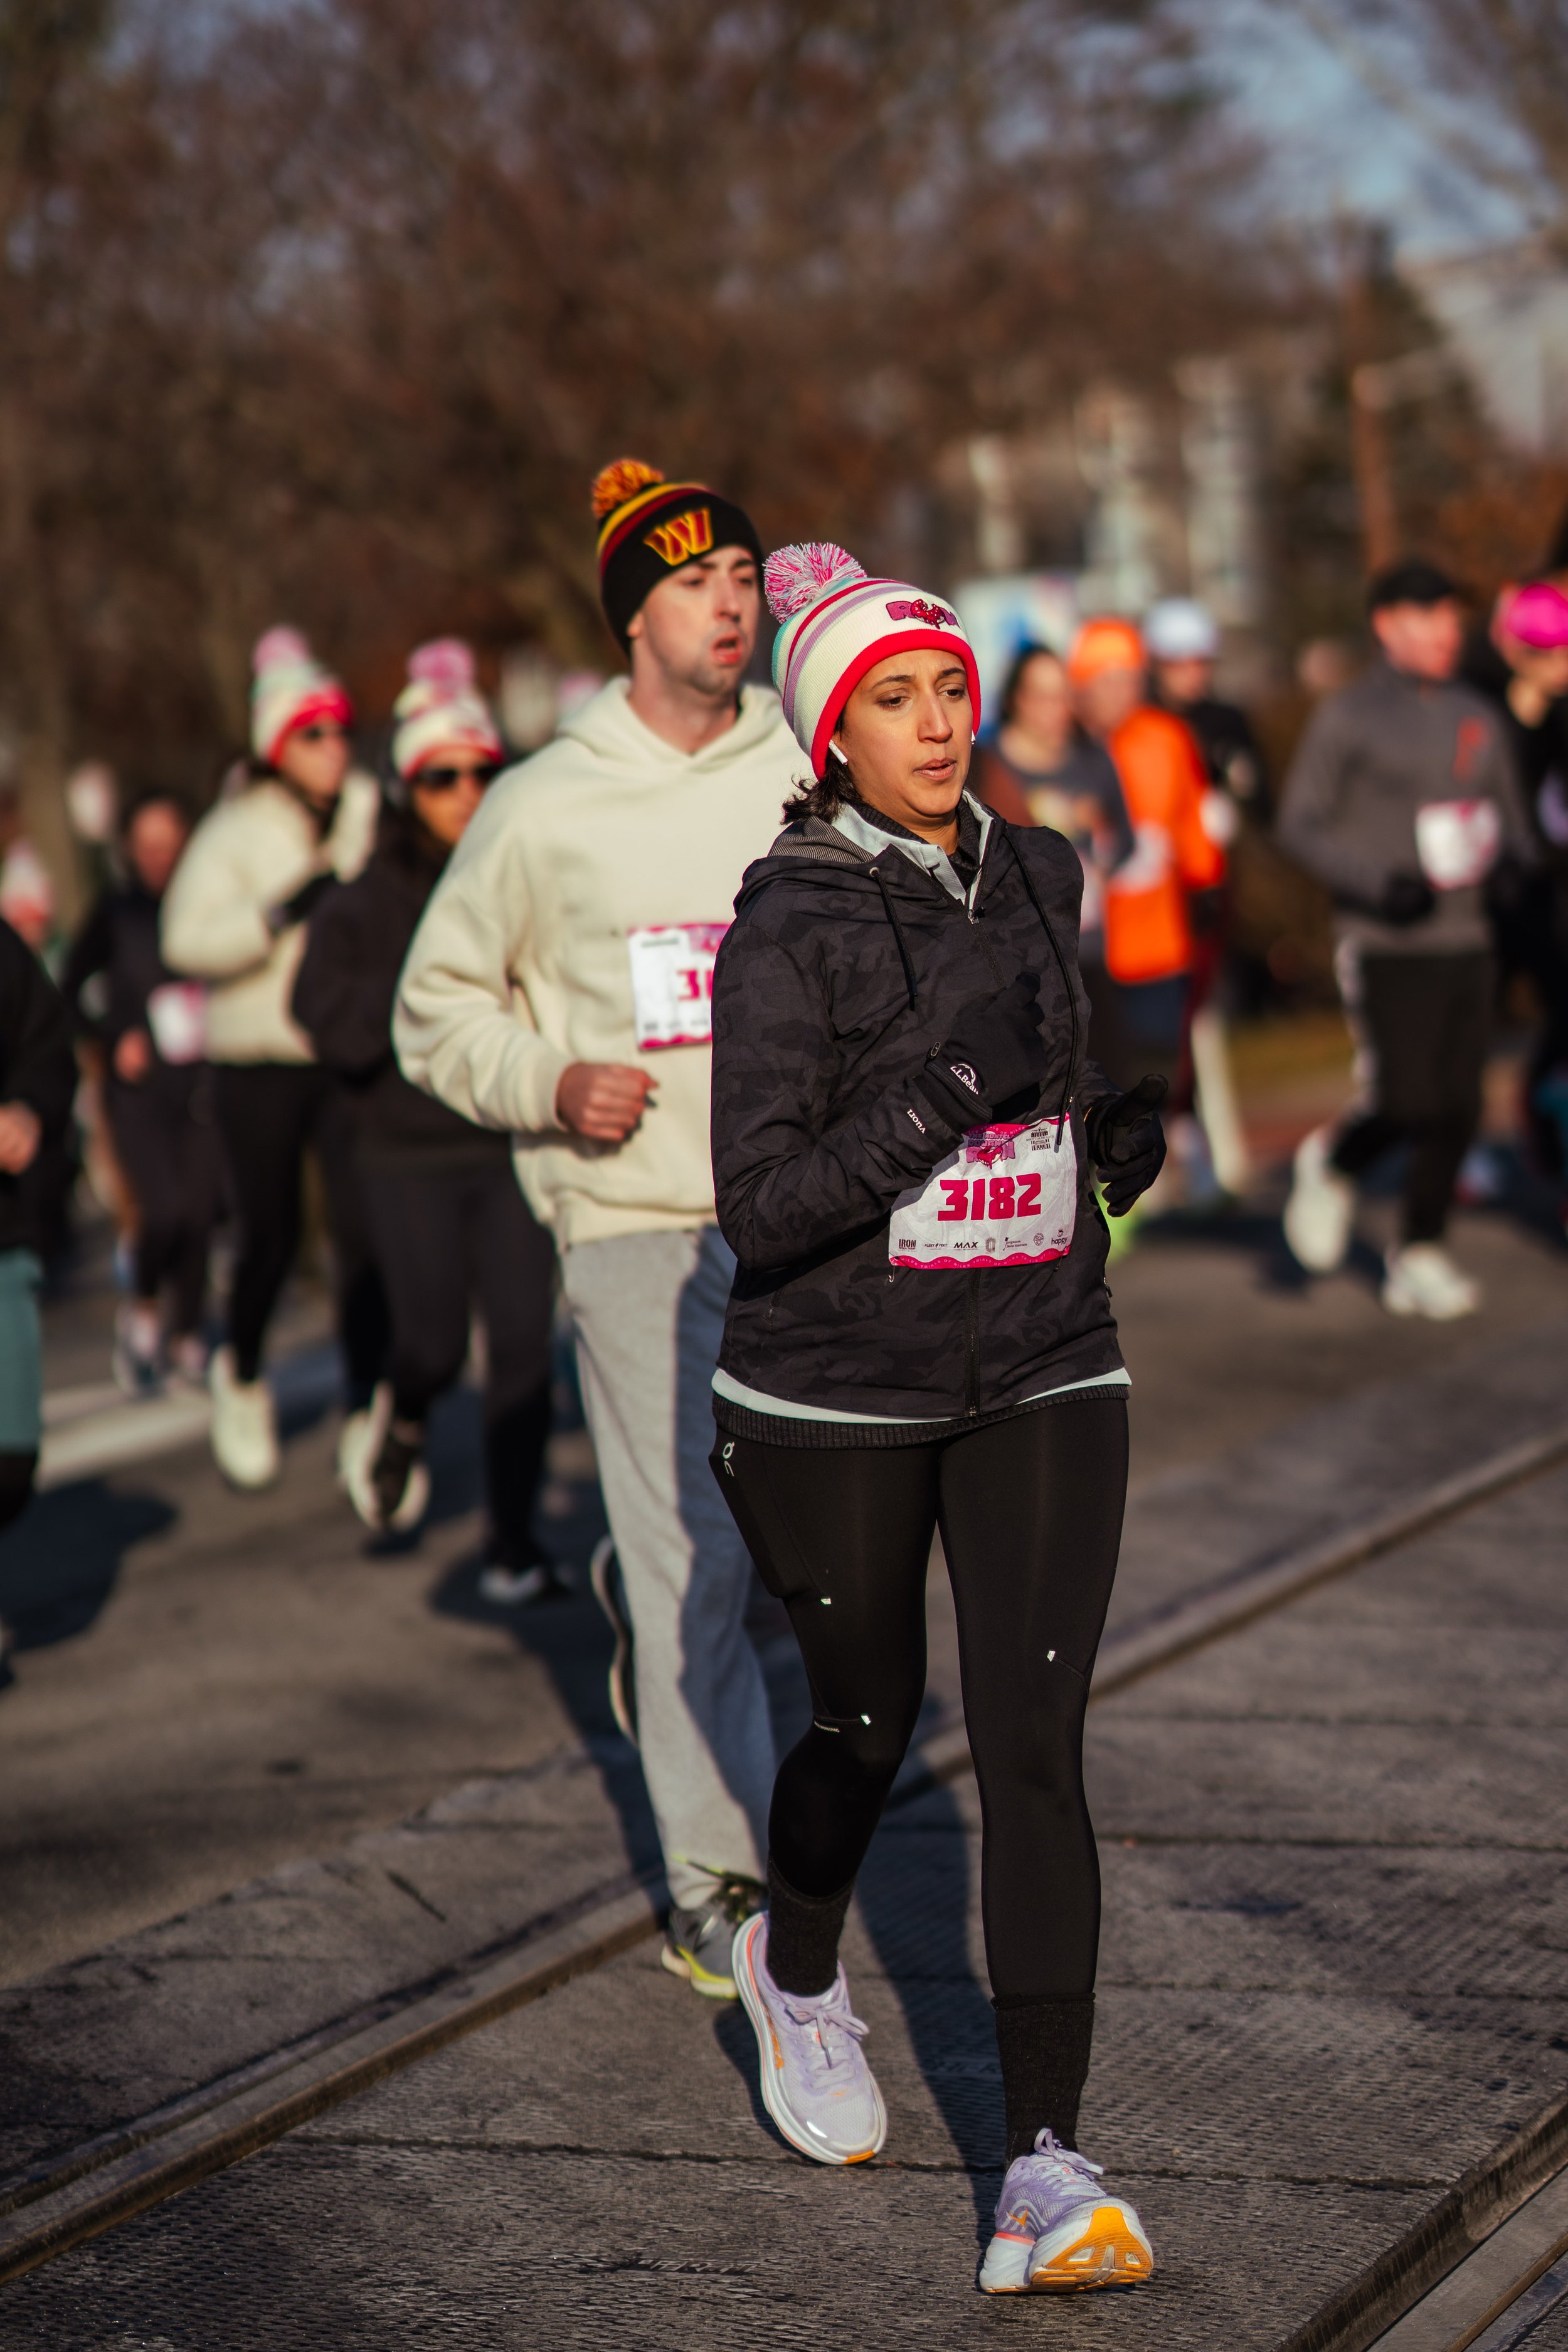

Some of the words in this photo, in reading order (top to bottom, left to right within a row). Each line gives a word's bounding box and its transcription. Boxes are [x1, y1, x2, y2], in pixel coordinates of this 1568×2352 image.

[643, 507, 714, 566] W
[937, 1173, 1041, 1221] 3182
[899, 1239, 916, 1248] IRON
[1051, 1237, 1068, 1246] happy
[920, 1259, 941, 1268] TRIALS
